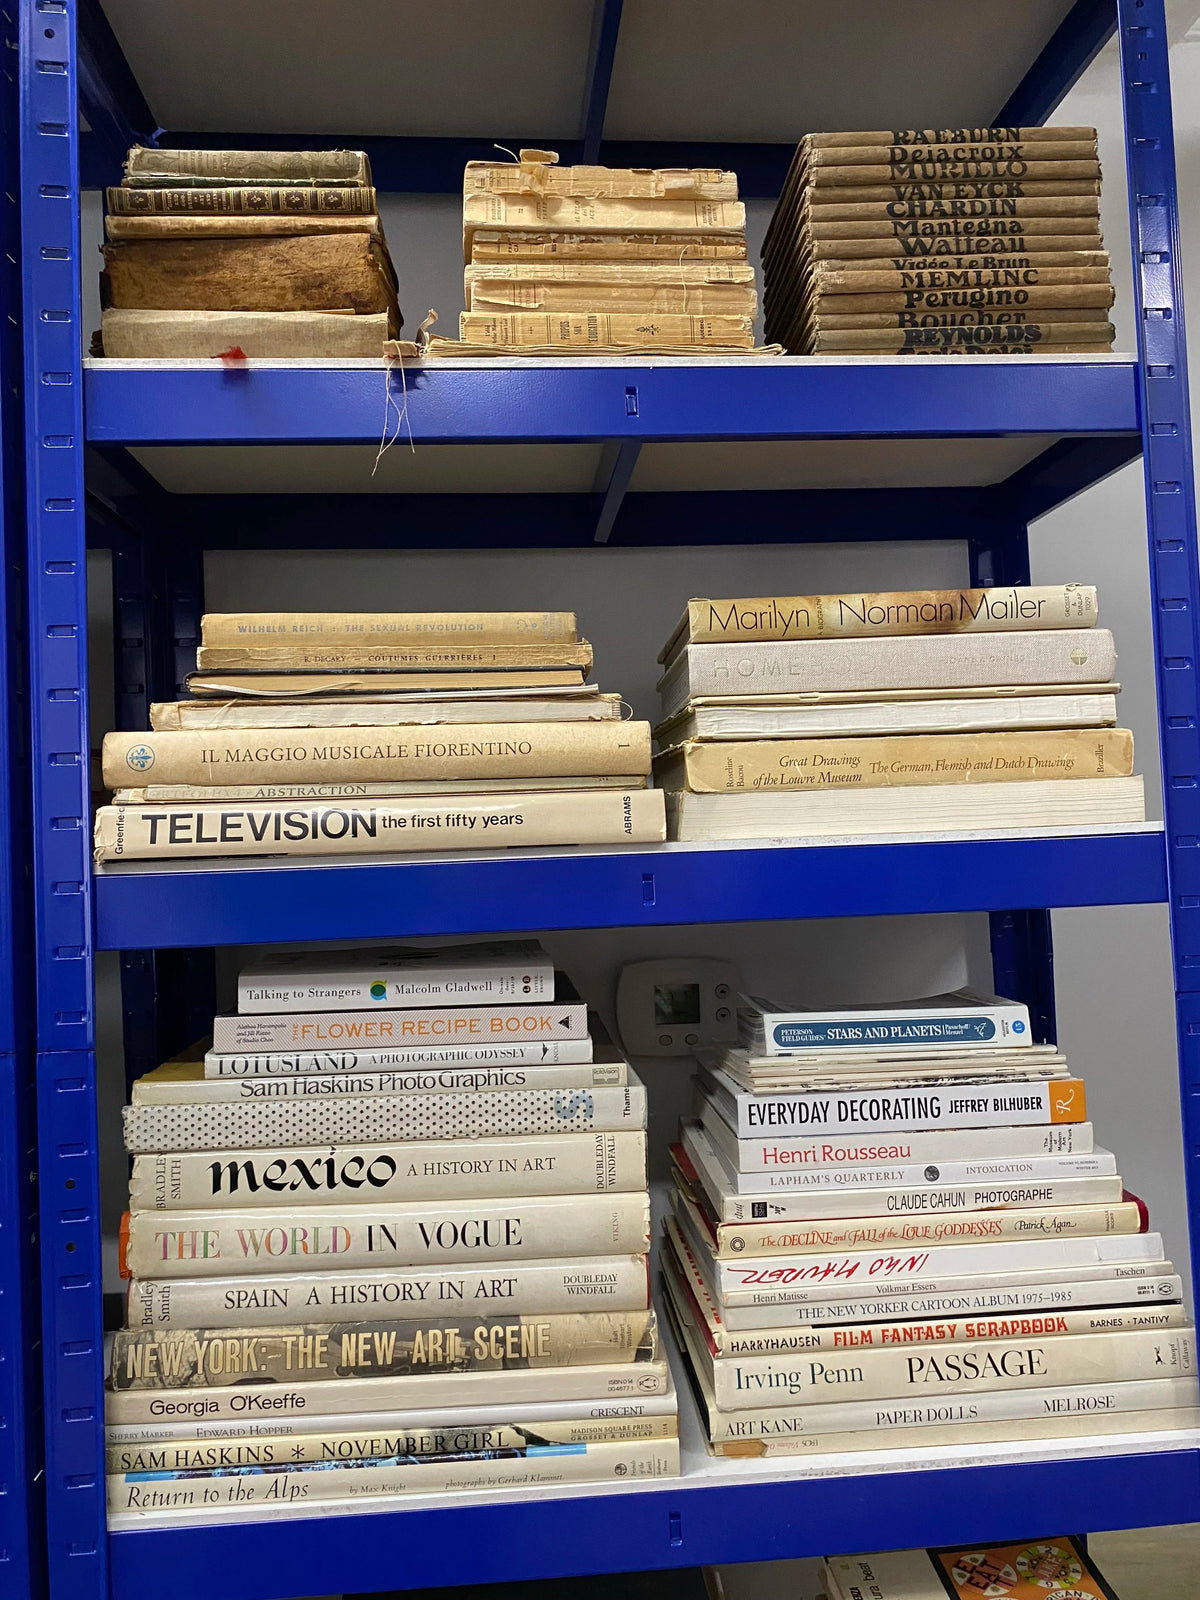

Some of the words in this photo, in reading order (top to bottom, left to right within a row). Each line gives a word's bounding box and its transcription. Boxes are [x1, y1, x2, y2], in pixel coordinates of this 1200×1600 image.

[893, 128, 1020, 145] RAEBURN
[889, 161, 1028, 180] MURILLO
[891, 184, 943, 200] VAN
[954, 182, 1025, 199] EYCK
[886, 199, 1017, 218] CHARDIN
[891, 219, 1024, 236] Mantegna
[900, 269, 1040, 288] MEMLINC
[904, 287, 1029, 309] Perugino
[897, 309, 1026, 328] Boucher
[902, 325, 1043, 347] REYNOLDS
[709, 600, 810, 637] Marilyn
[838, 598, 953, 627] Norman
[958, 589, 1047, 621] Mailer
[238, 624, 286, 633] WILHELM
[292, 624, 323, 632] REICH
[345, 623, 365, 632] THE
[369, 623, 411, 632] SEXUAL
[416, 623, 484, 632] REVOLUTION
[201, 749, 220, 763] IL
[225, 746, 307, 763] MAGGIO
[312, 744, 409, 761] MUSICALE
[414, 741, 533, 758] FIORENTINO
[779, 755, 808, 768] Great
[813, 753, 861, 769] Drawings
[869, 761, 889, 774] The
[935, 757, 972, 772] Flemish
[973, 757, 993, 770] and
[994, 756, 1025, 770] Dutch
[1027, 755, 1075, 771] Drawings
[780, 773, 815, 785] Louvre
[818, 771, 863, 784] Museum
[255, 785, 367, 797] ABSTRACTION
[142, 807, 377, 845] TELEVISION
[381, 815, 407, 829] the
[410, 813, 441, 828] first
[445, 812, 477, 830] fifty
[482, 813, 524, 829] years
[622, 795, 632, 835] ABRAMS
[247, 988, 289, 1002] Talking
[293, 989, 304, 999] to
[308, 987, 361, 1000] Strangers
[395, 984, 441, 995] Malcolm
[445, 981, 493, 993] Gladwell
[301, 1021, 393, 1040] FLOWER
[402, 1018, 481, 1036] RECIPE
[490, 1015, 553, 1033] BOOK
[781, 1028, 813, 1036] PETERSON
[827, 1027, 862, 1040] STARS
[864, 1025, 889, 1039] AND
[891, 1023, 942, 1038] PLANETS
[217, 1051, 359, 1076] LOTUSLAND
[380, 1050, 473, 1064] PHOTOGRAPHIC
[475, 1047, 526, 1060] ODYSSEY
[240, 1079, 288, 1098] Sam
[292, 1074, 374, 1096] Haskins
[379, 1071, 436, 1091] Photo
[438, 1068, 526, 1091] Graphics
[623, 1087, 631, 1118] Thame
[748, 1100, 830, 1126] EVERYDAY
[837, 1096, 941, 1123] DECORATING
[948, 1098, 989, 1114] JEFFREY
[993, 1096, 1043, 1112] BILHUBER
[1056, 1088, 1075, 1115] R
[595, 1133, 605, 1190] DOUBLEDAY
[608, 1135, 617, 1187] WINDFALL
[762, 1145, 817, 1165] Henri
[822, 1144, 911, 1162] Rousseau
[171, 1159, 181, 1200] SMITH
[207, 1145, 398, 1195] mexico
[407, 1163, 418, 1177] A
[423, 1159, 494, 1176] HISTORY
[498, 1158, 518, 1173] IN
[523, 1157, 556, 1171] ART
[770, 1173, 831, 1186] LAPHAM'S
[834, 1171, 905, 1184] QUARTERLY
[966, 1163, 1034, 1175] INTOXICATION
[887, 1193, 928, 1211] CLAUDE
[929, 1191, 966, 1209] CAHUN
[974, 1188, 1053, 1204] PHOTOGRAPHE
[155, 1230, 221, 1261] THE
[235, 1226, 352, 1258] WORLD
[365, 1223, 398, 1252] IN
[418, 1218, 523, 1250] VOGUE
[778, 1229, 837, 1248] DECLINE
[934, 1218, 1004, 1242] GODDESSES
[562, 1273, 618, 1285] DOUBLEDAY
[567, 1285, 616, 1296] WINDFALL
[753, 1293, 777, 1304] Henri
[778, 1290, 808, 1302] Matisse
[876, 1283, 910, 1295] Volkmar
[912, 1281, 937, 1292] Essers
[1114, 1266, 1146, 1278] Taschen
[142, 1281, 158, 1327] Bradley
[158, 1285, 171, 1322] Smith
[224, 1288, 290, 1310] SPAIN
[305, 1286, 322, 1306] A
[330, 1281, 432, 1305] HISTORY
[438, 1280, 465, 1300] IN
[473, 1277, 518, 1299] ART
[796, 1307, 825, 1320] THE
[827, 1304, 858, 1318] NEW
[860, 1301, 909, 1316] YORKER
[911, 1297, 970, 1312] CARTOON
[973, 1294, 1019, 1308] ALBUM
[730, 1335, 821, 1352] HARRYHAUSEN
[833, 1330, 873, 1347] FILM
[881, 1323, 958, 1344] FANTASY
[965, 1316, 1069, 1338] SCRAPBOOK
[1090, 1317, 1123, 1328] BARNES
[1132, 1315, 1170, 1326] TANTIVY
[126, 1340, 185, 1379] NEW
[194, 1337, 268, 1376] YORK:
[282, 1333, 329, 1370] THE
[341, 1331, 397, 1368] NEW
[411, 1327, 460, 1365] ART
[473, 1322, 552, 1361] SCENE
[1182, 1338, 1190, 1369] Callaway
[735, 1365, 802, 1395] Irving
[809, 1361, 864, 1386] Penn
[905, 1348, 1048, 1384] PASSAGE
[150, 1398, 220, 1417] Georgia
[230, 1392, 306, 1411] O'Keeffe
[725, 1421, 757, 1437] ART
[760, 1417, 804, 1435] KANE
[876, 1409, 923, 1426] PAPER
[927, 1405, 978, 1422] DOLLS
[1043, 1395, 1116, 1414] MELROSE
[196, 1427, 246, 1439] EDWARD
[250, 1424, 293, 1436] HOPPER
[590, 1405, 645, 1418] CRESCENT
[120, 1451, 167, 1471] SAM
[175, 1445, 275, 1467] HASKINS
[321, 1433, 452, 1460] NOVEMBER
[453, 1430, 510, 1451] GIRL
[126, 1485, 194, 1508] Return
[203, 1487, 220, 1502] to
[228, 1479, 255, 1501] the
[264, 1475, 309, 1504] Alps
[445, 1477, 486, 1490] photographs
[498, 1474, 528, 1484] Gerhard
[857, 1562, 875, 1581] beat
